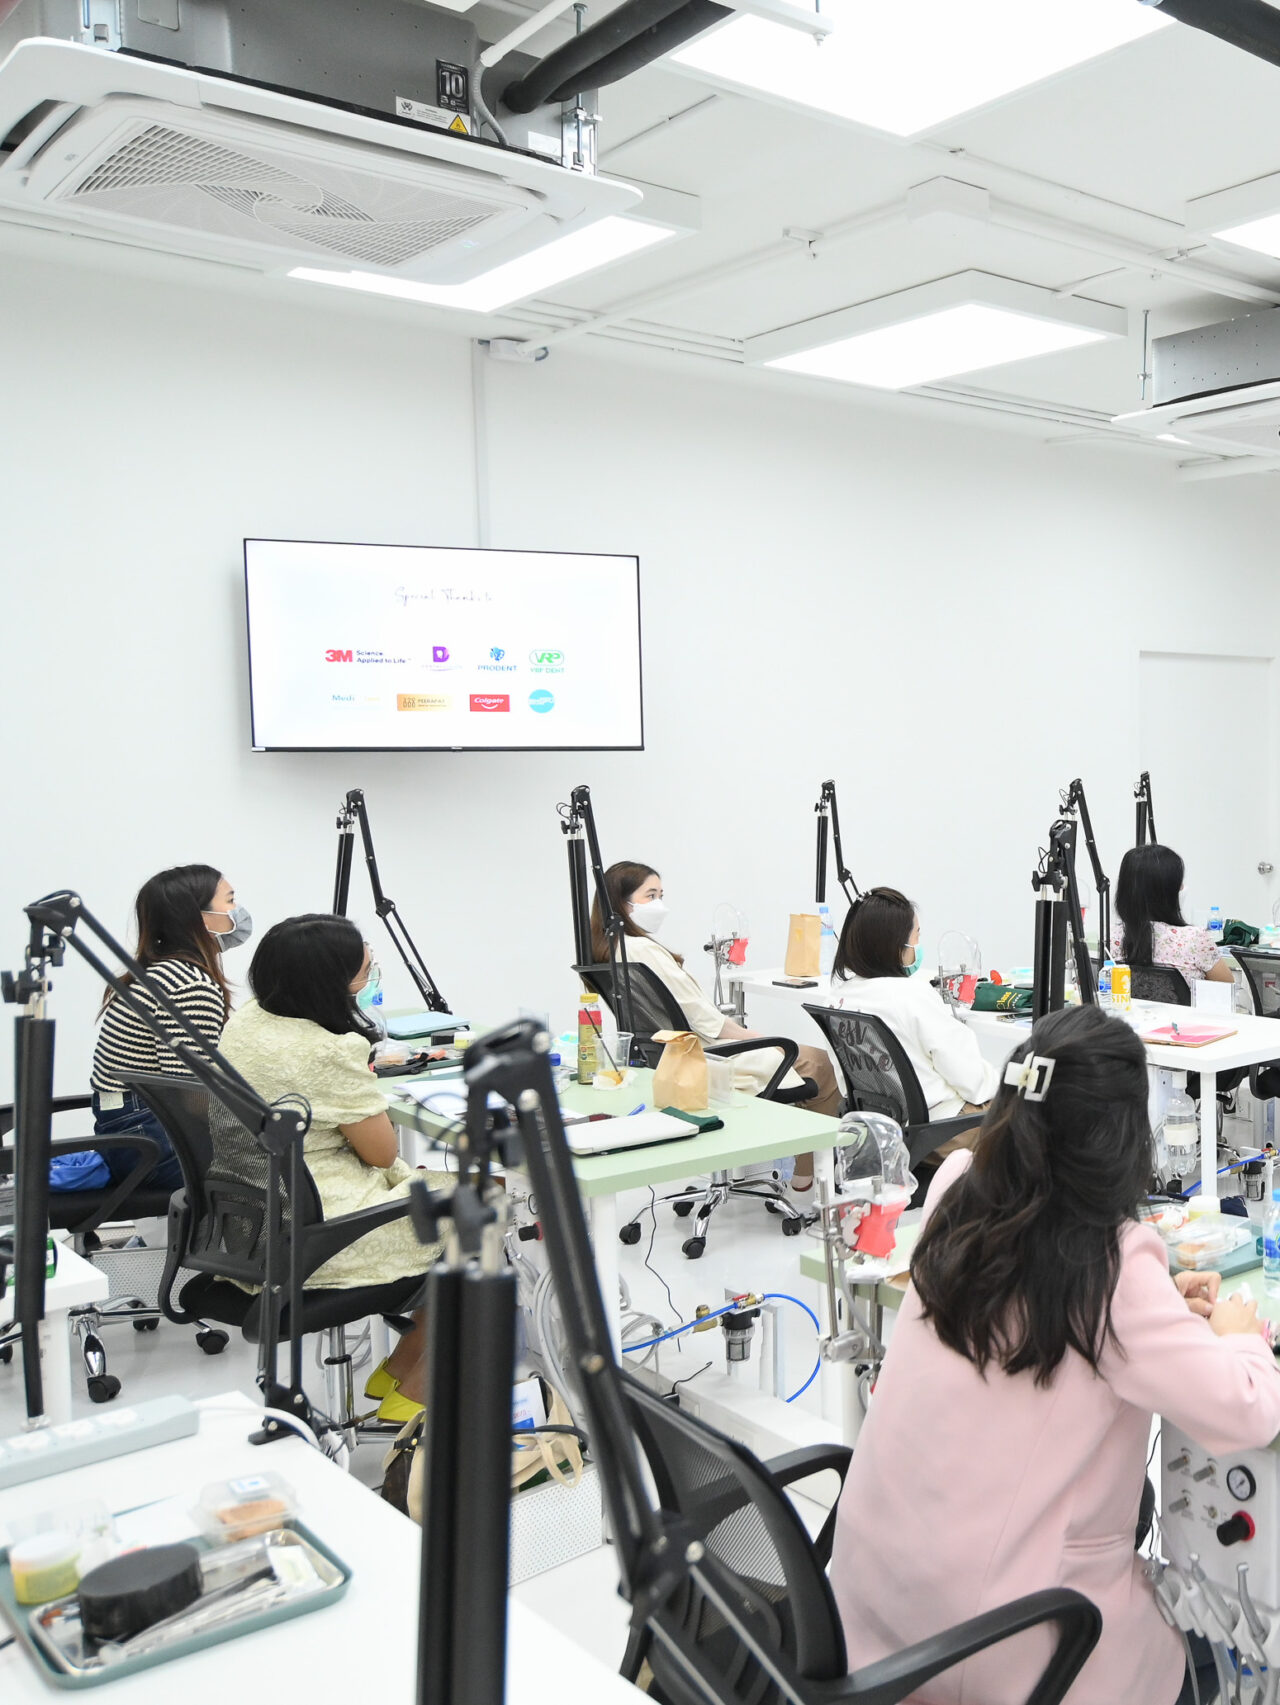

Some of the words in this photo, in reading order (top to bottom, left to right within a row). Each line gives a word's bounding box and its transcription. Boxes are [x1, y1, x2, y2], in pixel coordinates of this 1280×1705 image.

[441, 71, 464, 98] 10
[325, 649, 353, 663] 3M
[477, 664, 518, 672] PRODENT
